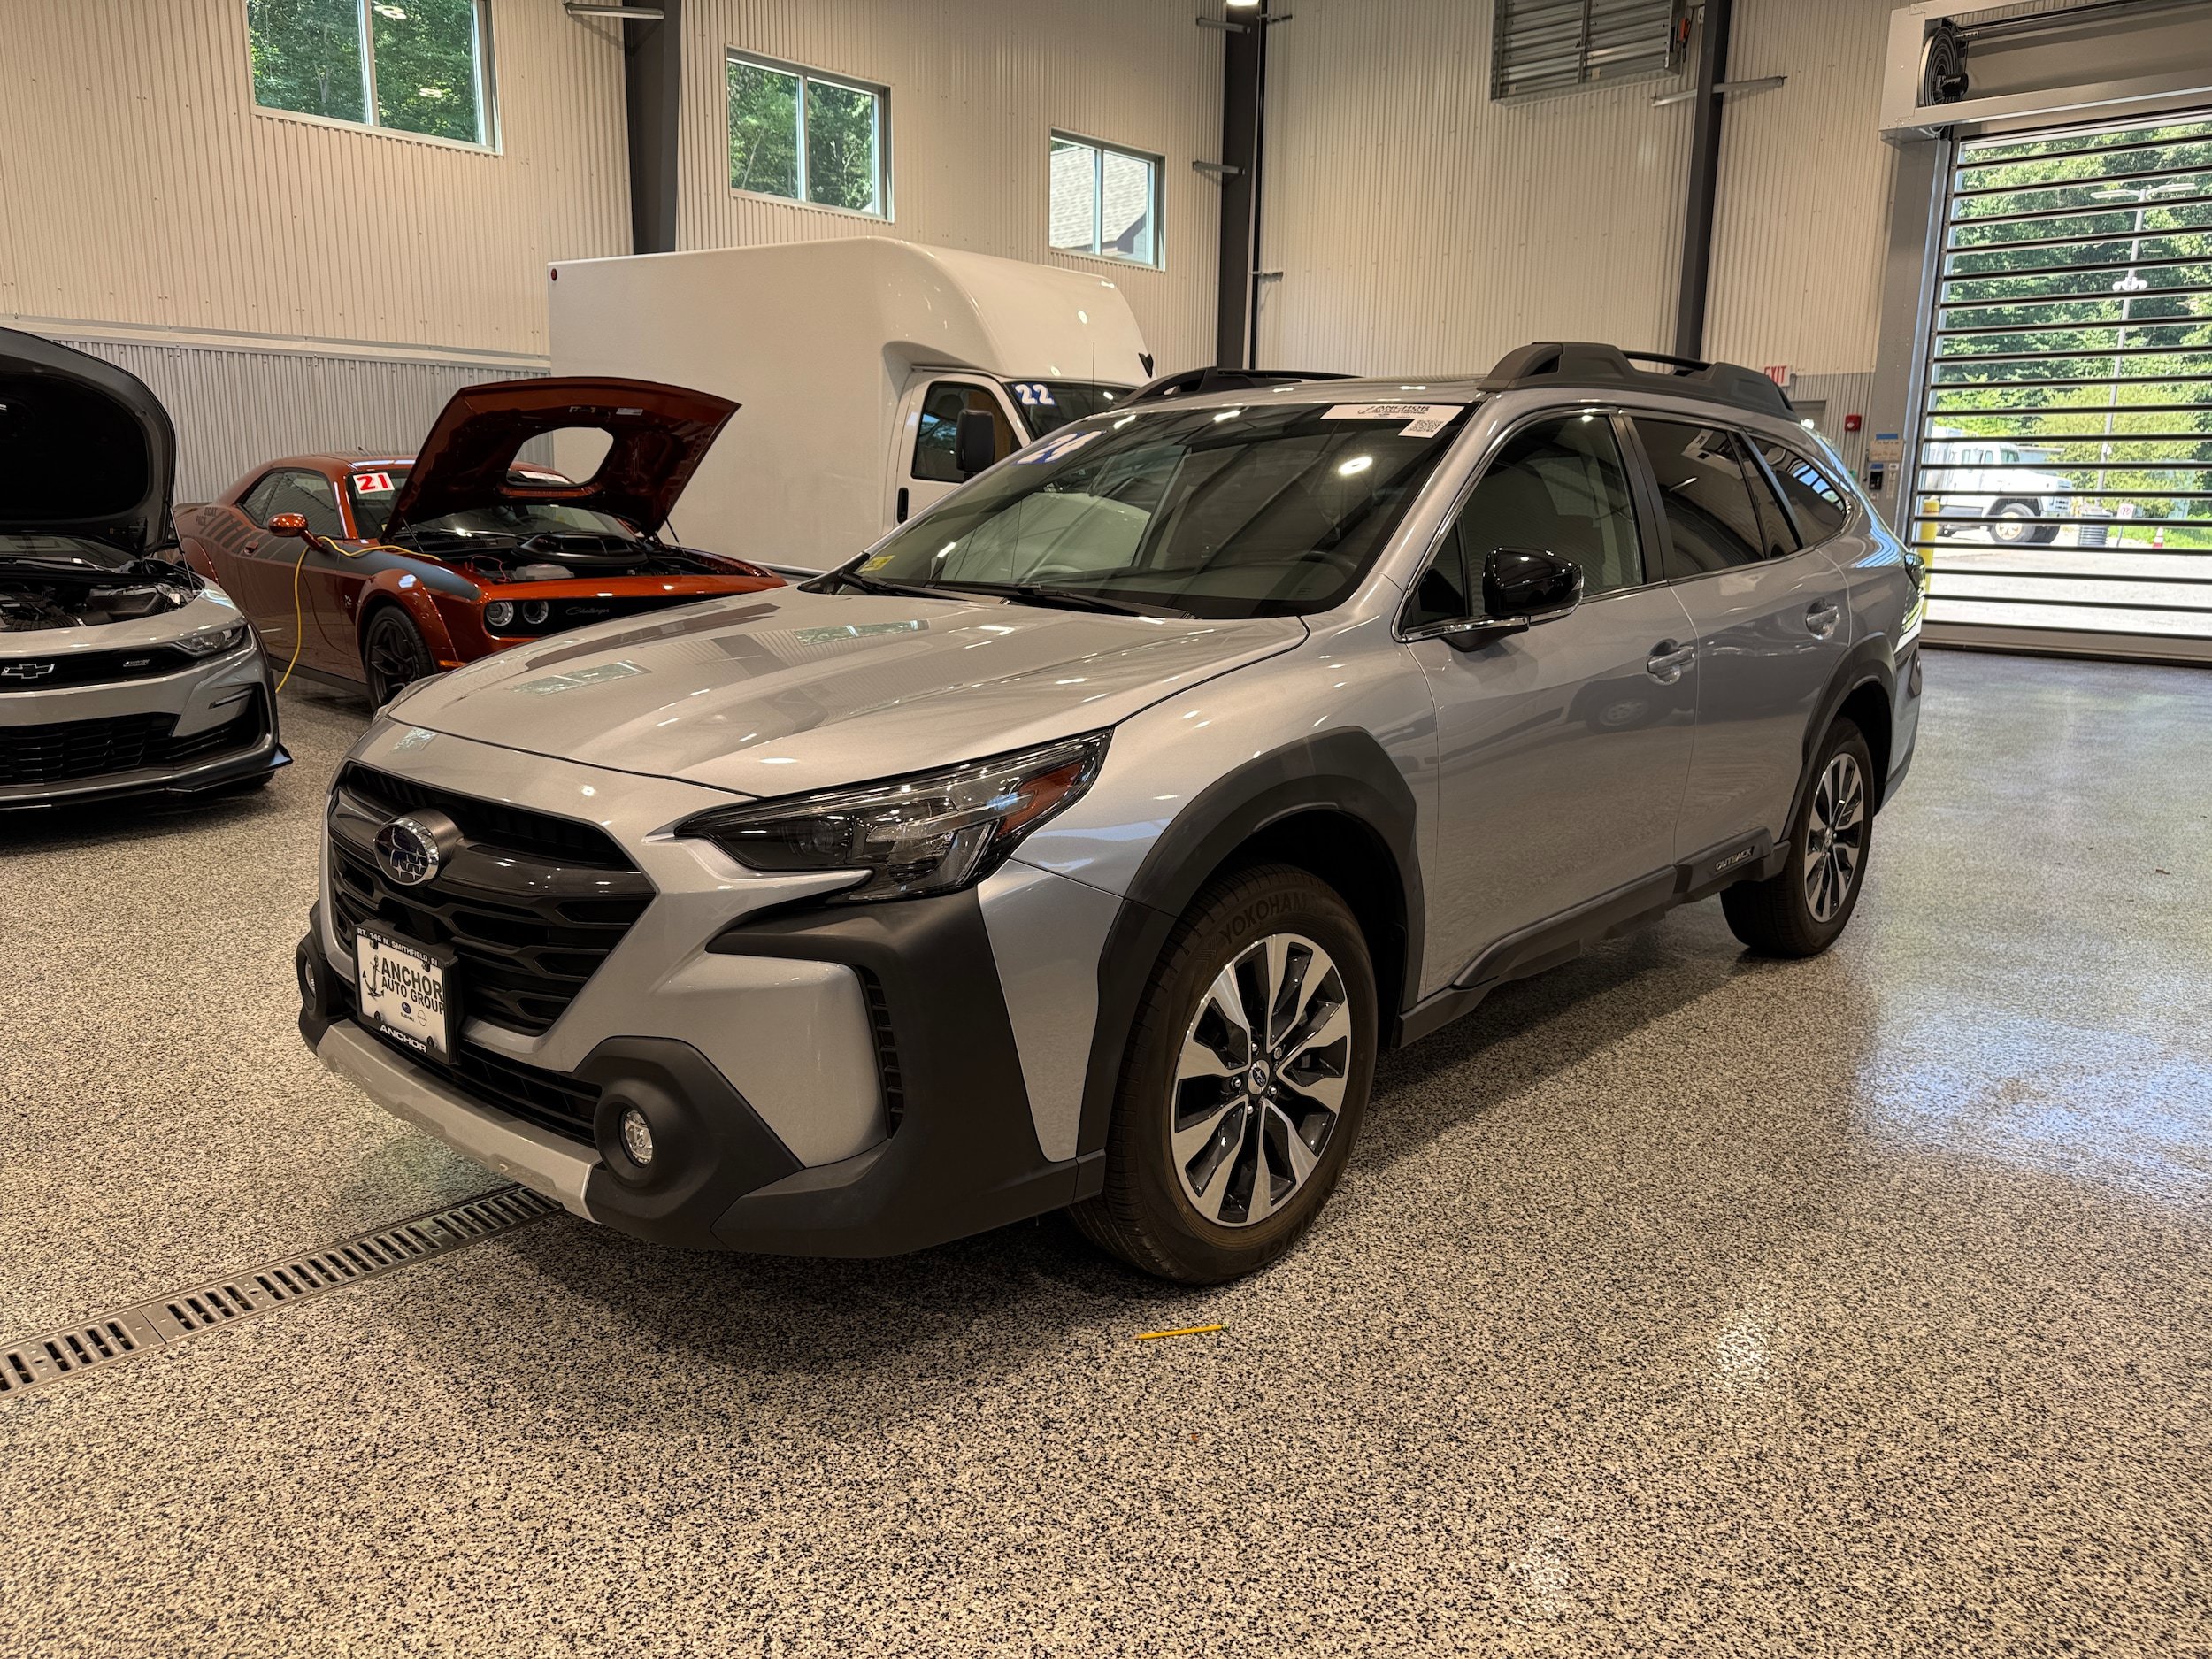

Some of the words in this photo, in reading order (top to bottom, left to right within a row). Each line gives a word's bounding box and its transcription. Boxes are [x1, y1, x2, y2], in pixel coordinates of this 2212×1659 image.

[1015, 384, 1054, 405] 22
[357, 474, 388, 490] 21
[1219, 892, 1313, 944] YOKOHAM
[369, 933, 381, 942] 146
[381, 958, 444, 1002] ANCHOR
[381, 978, 407, 998] AUTO
[380, 1025, 426, 1053] ANCHOR
